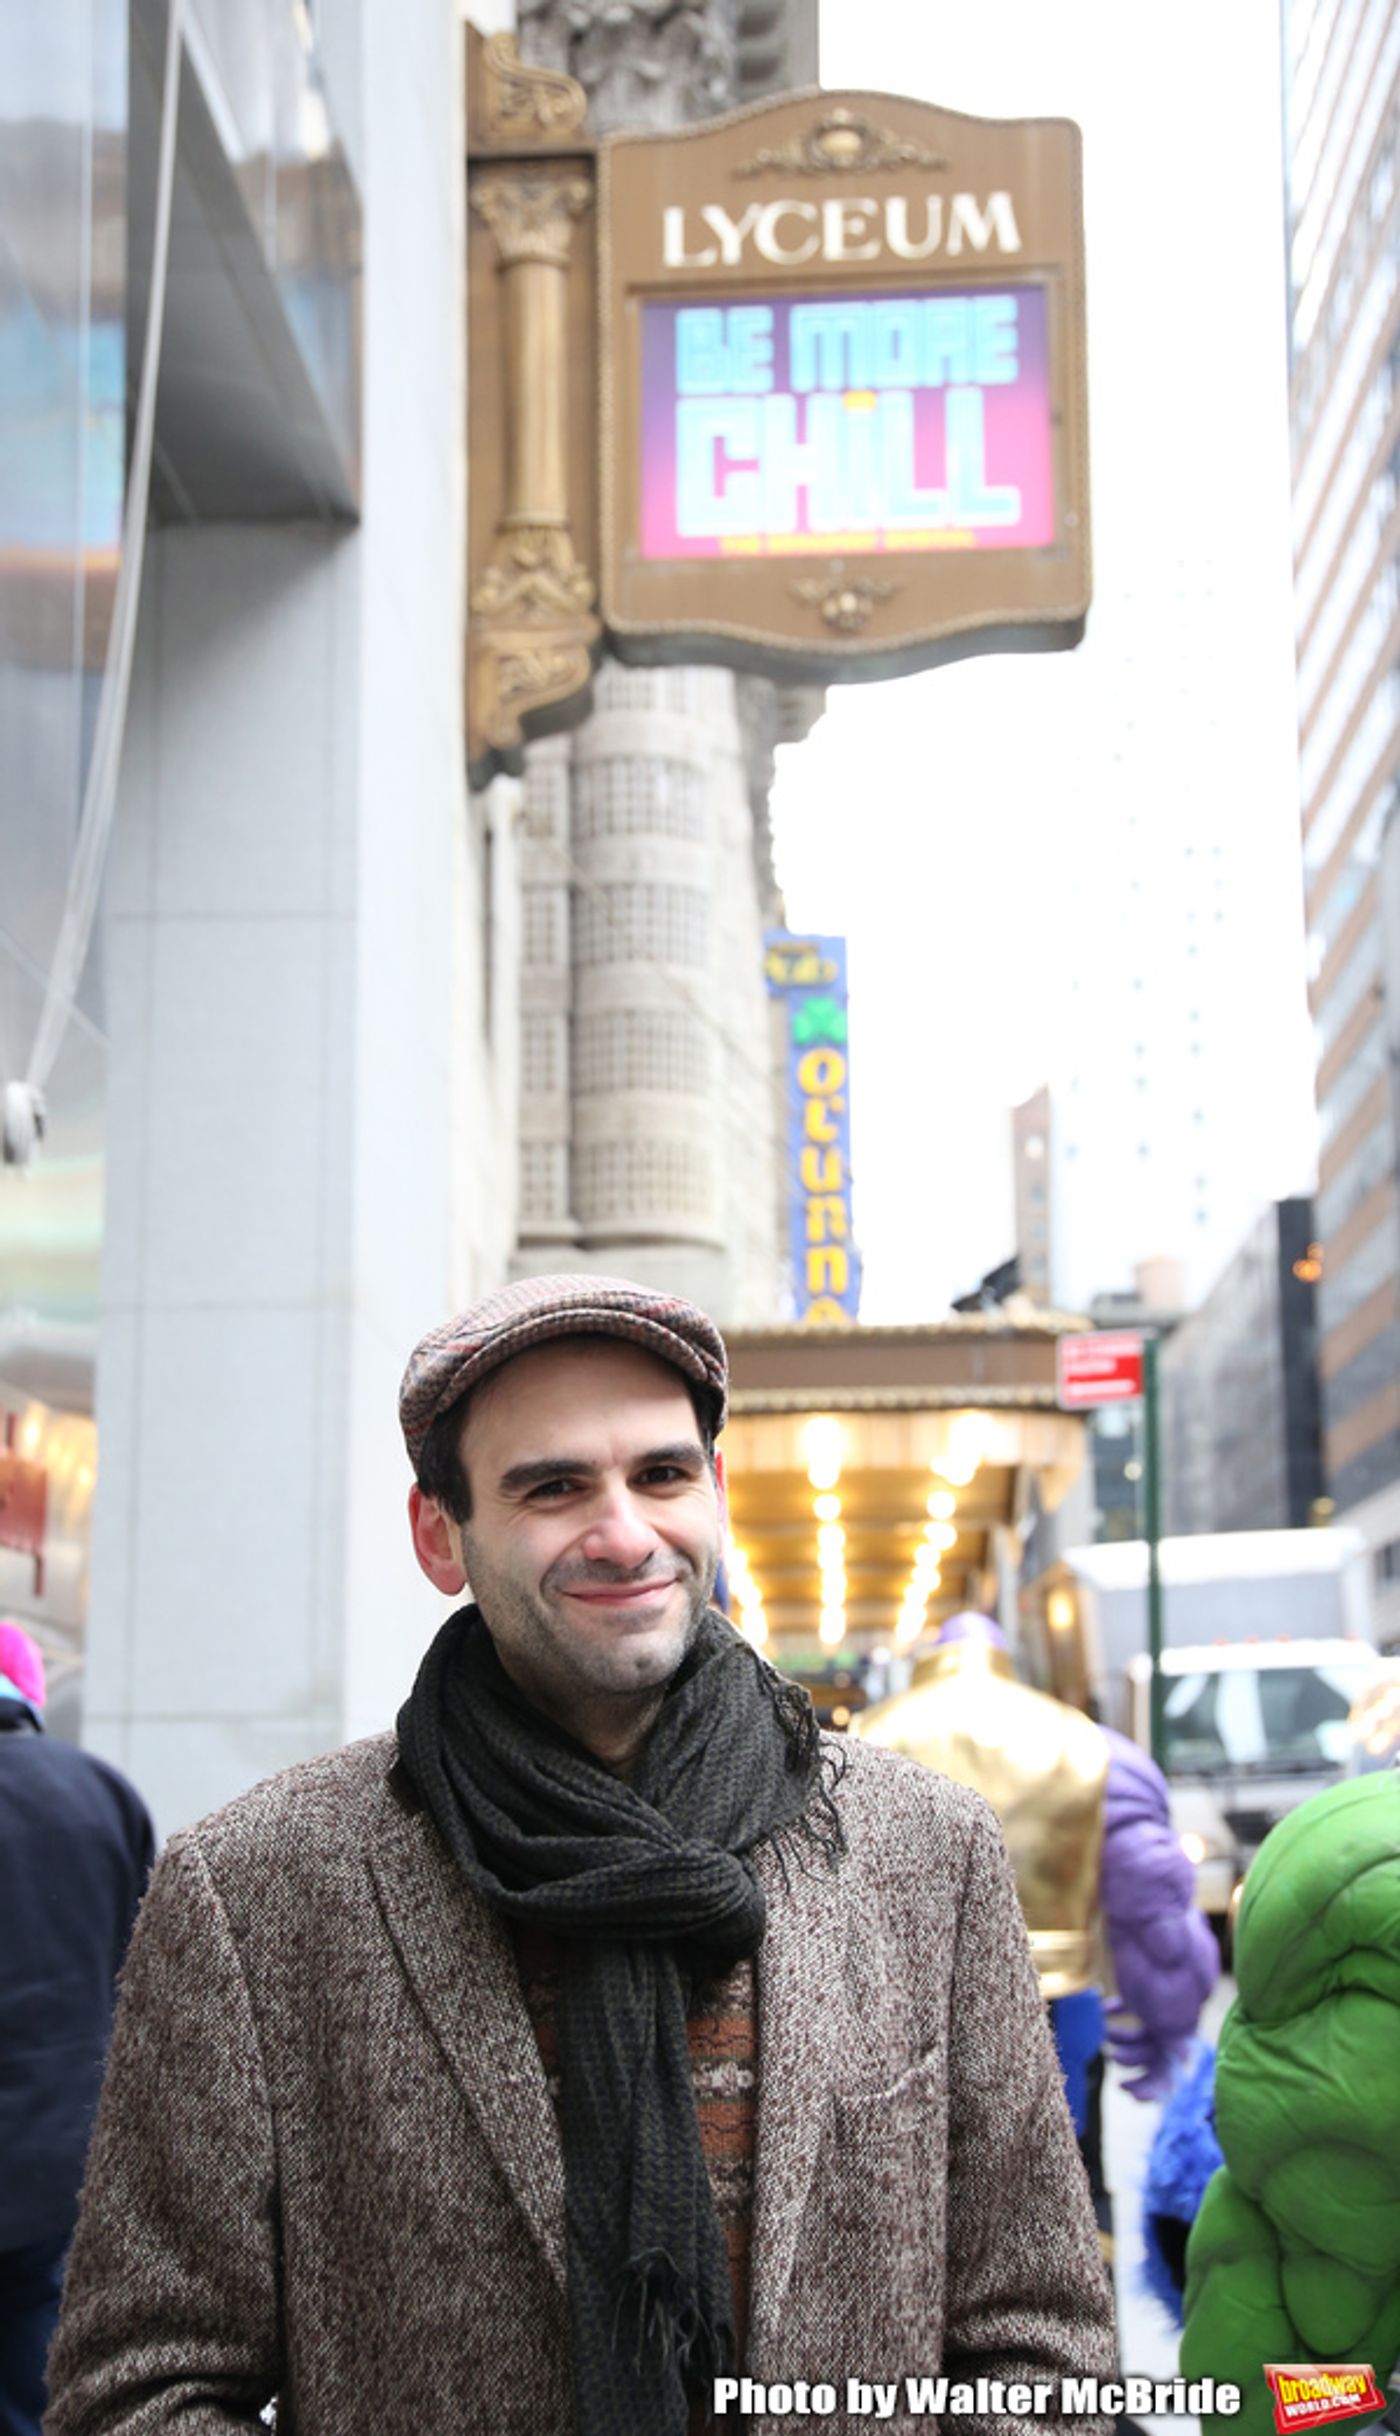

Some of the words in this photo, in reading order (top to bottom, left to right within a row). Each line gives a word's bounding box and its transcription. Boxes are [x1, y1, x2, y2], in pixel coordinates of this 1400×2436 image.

[663, 191, 1021, 267] LYCEUM
[676, 306, 774, 396] BE
[789, 295, 1018, 393] MORE
[676, 386, 1021, 537] CHILL
